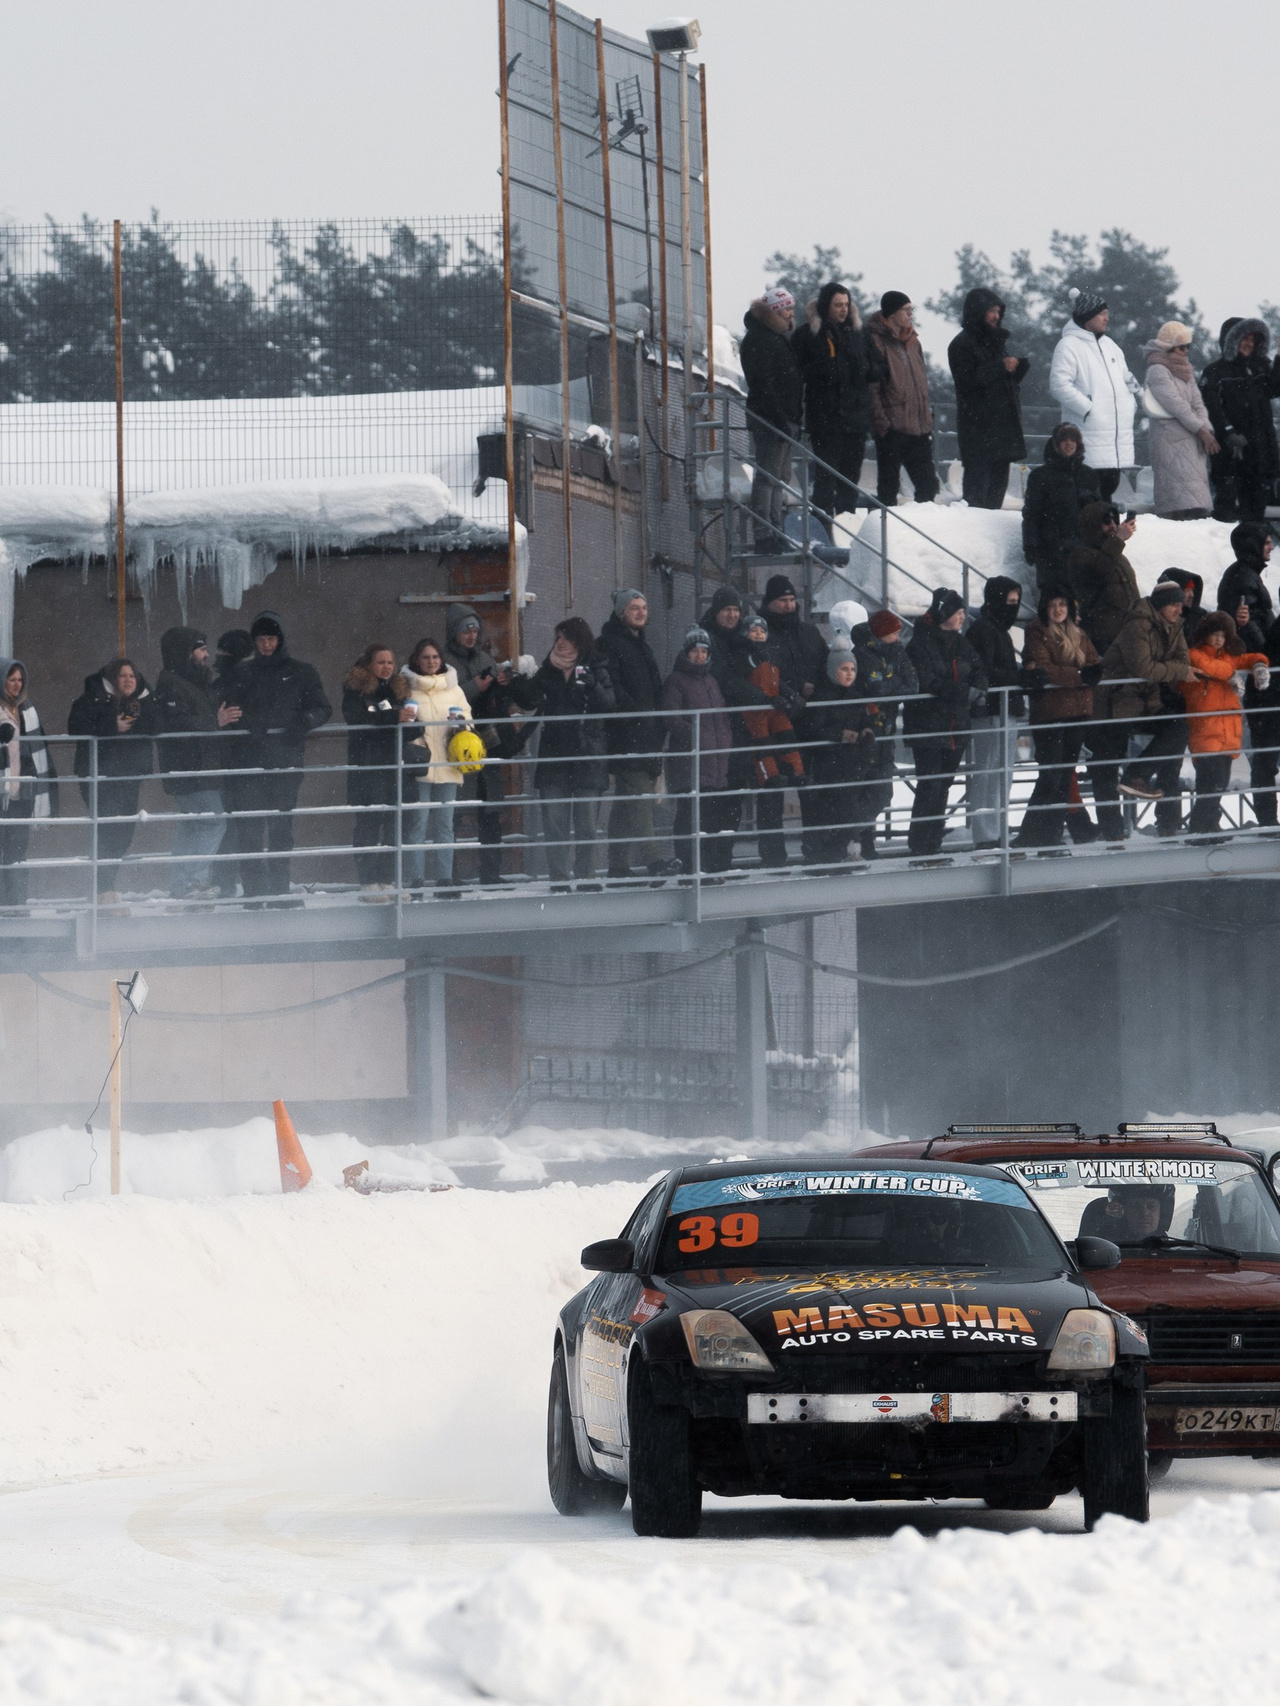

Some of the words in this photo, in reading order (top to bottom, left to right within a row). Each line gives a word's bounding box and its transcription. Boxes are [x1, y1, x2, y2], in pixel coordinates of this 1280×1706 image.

[1024, 1163, 1066, 1175] DRIFT
[1077, 1161, 1159, 1178] WINTER
[1162, 1162, 1216, 1179] MODE
[757, 1179, 801, 1190] DRIFT
[806, 1176, 907, 1191] WINTER
[912, 1177, 967, 1193] CUP
[679, 1212, 759, 1253] 39
[772, 1303, 1035, 1335] MASUMA
[781, 1332, 851, 1349] AUTO
[859, 1329, 945, 1340] SPARE
[952, 1329, 1038, 1347] PARTS
